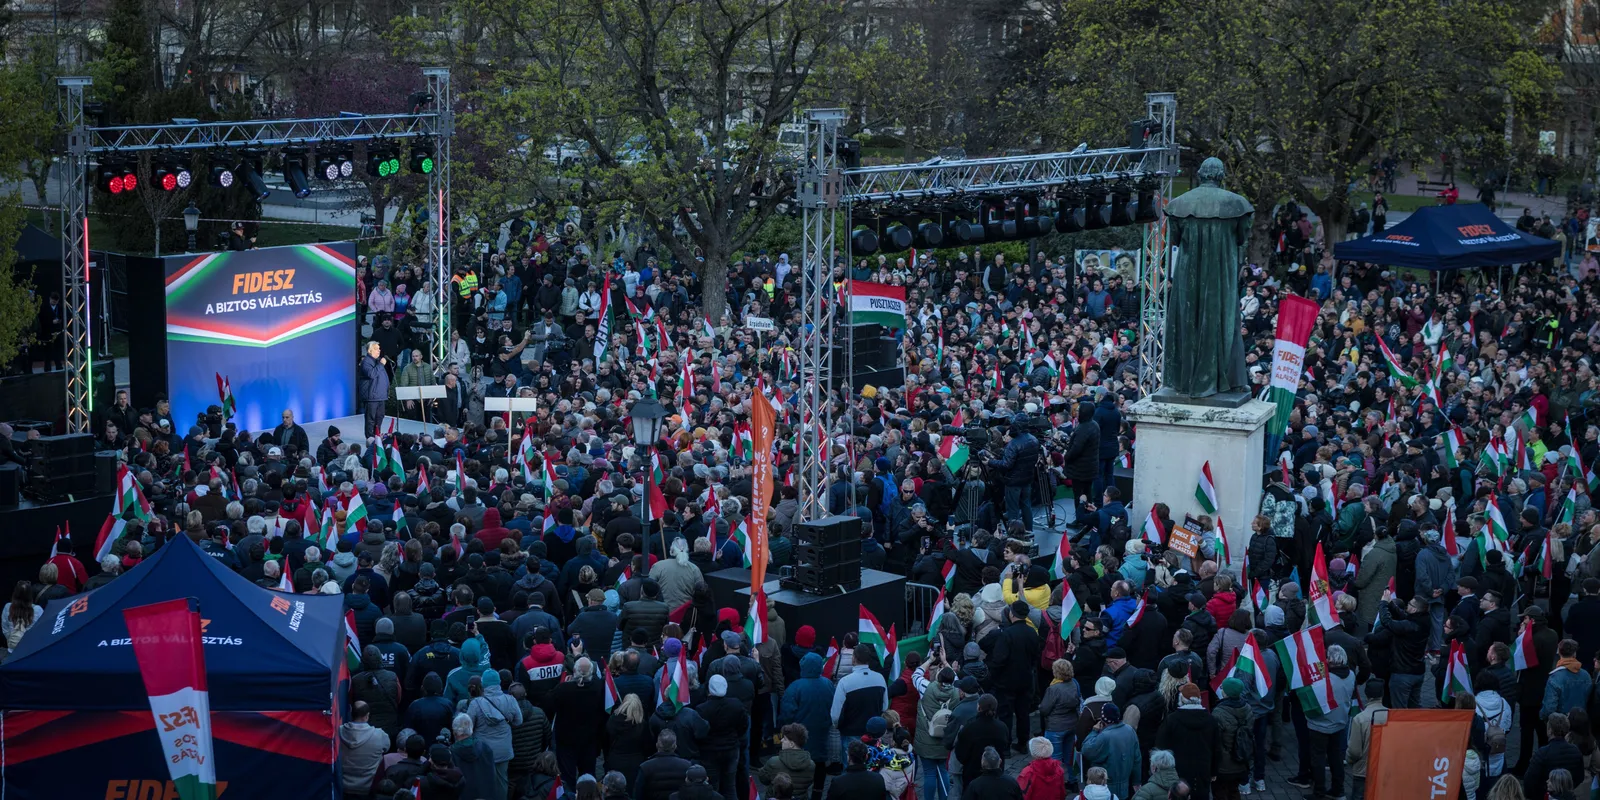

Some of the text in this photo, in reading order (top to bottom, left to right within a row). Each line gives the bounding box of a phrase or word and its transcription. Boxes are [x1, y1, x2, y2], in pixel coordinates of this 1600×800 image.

[1457, 224, 1496, 237] FIDESZ
[232, 268, 296, 295] FIDESZ
[205, 290, 323, 315] A BIZTOS VÁLASZTÁS
[870, 298, 902, 311] PUSZTASZER
[97, 639, 108, 648] A
